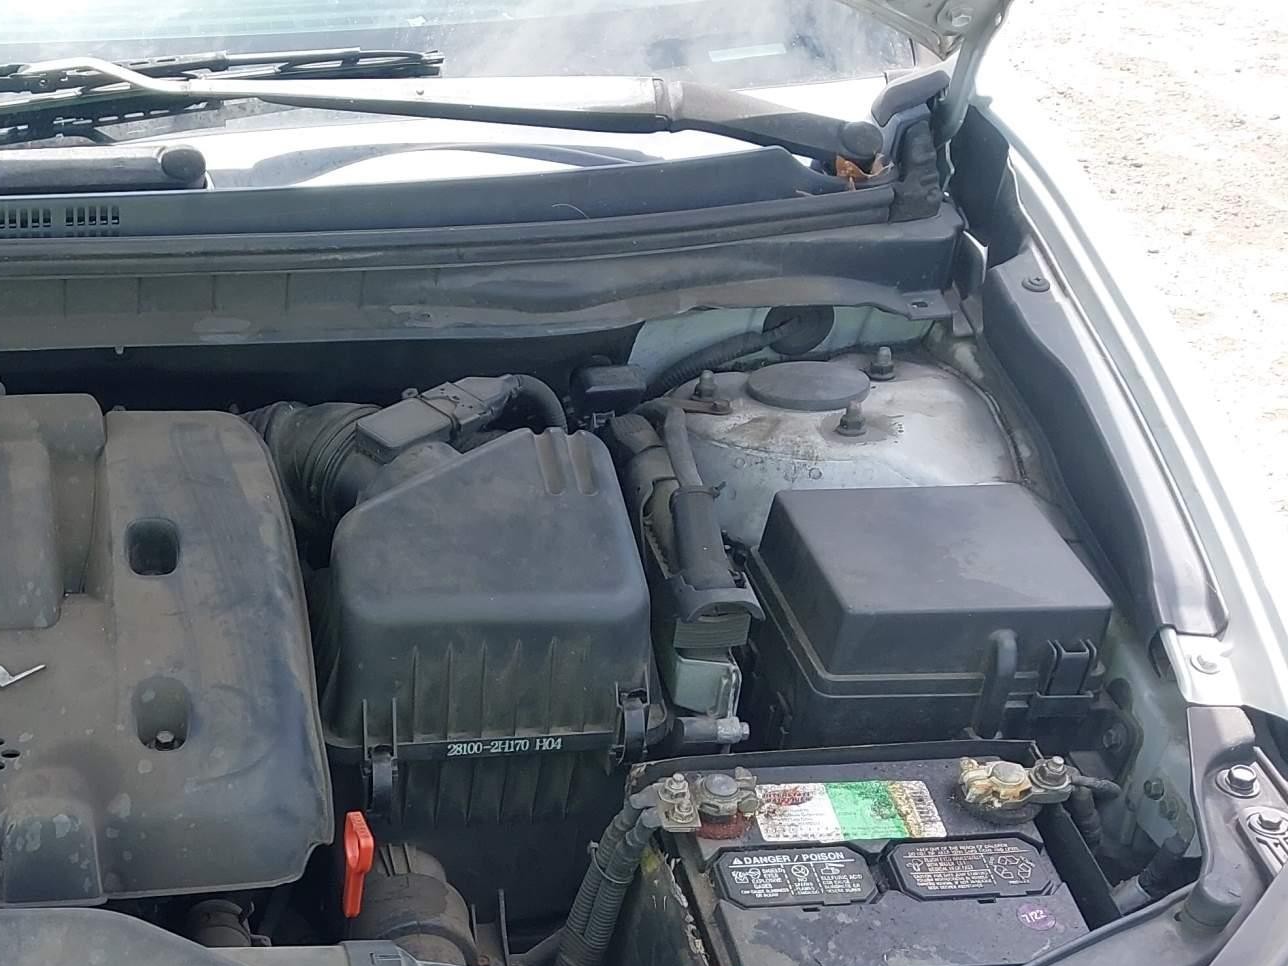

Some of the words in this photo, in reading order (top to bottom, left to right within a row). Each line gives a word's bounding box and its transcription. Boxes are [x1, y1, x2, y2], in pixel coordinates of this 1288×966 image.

[447, 739, 530, 757] 28100-2H170
[535, 737, 562, 750] H04
[743, 855, 791, 865] DANGER
[802, 852, 844, 861] POISON
